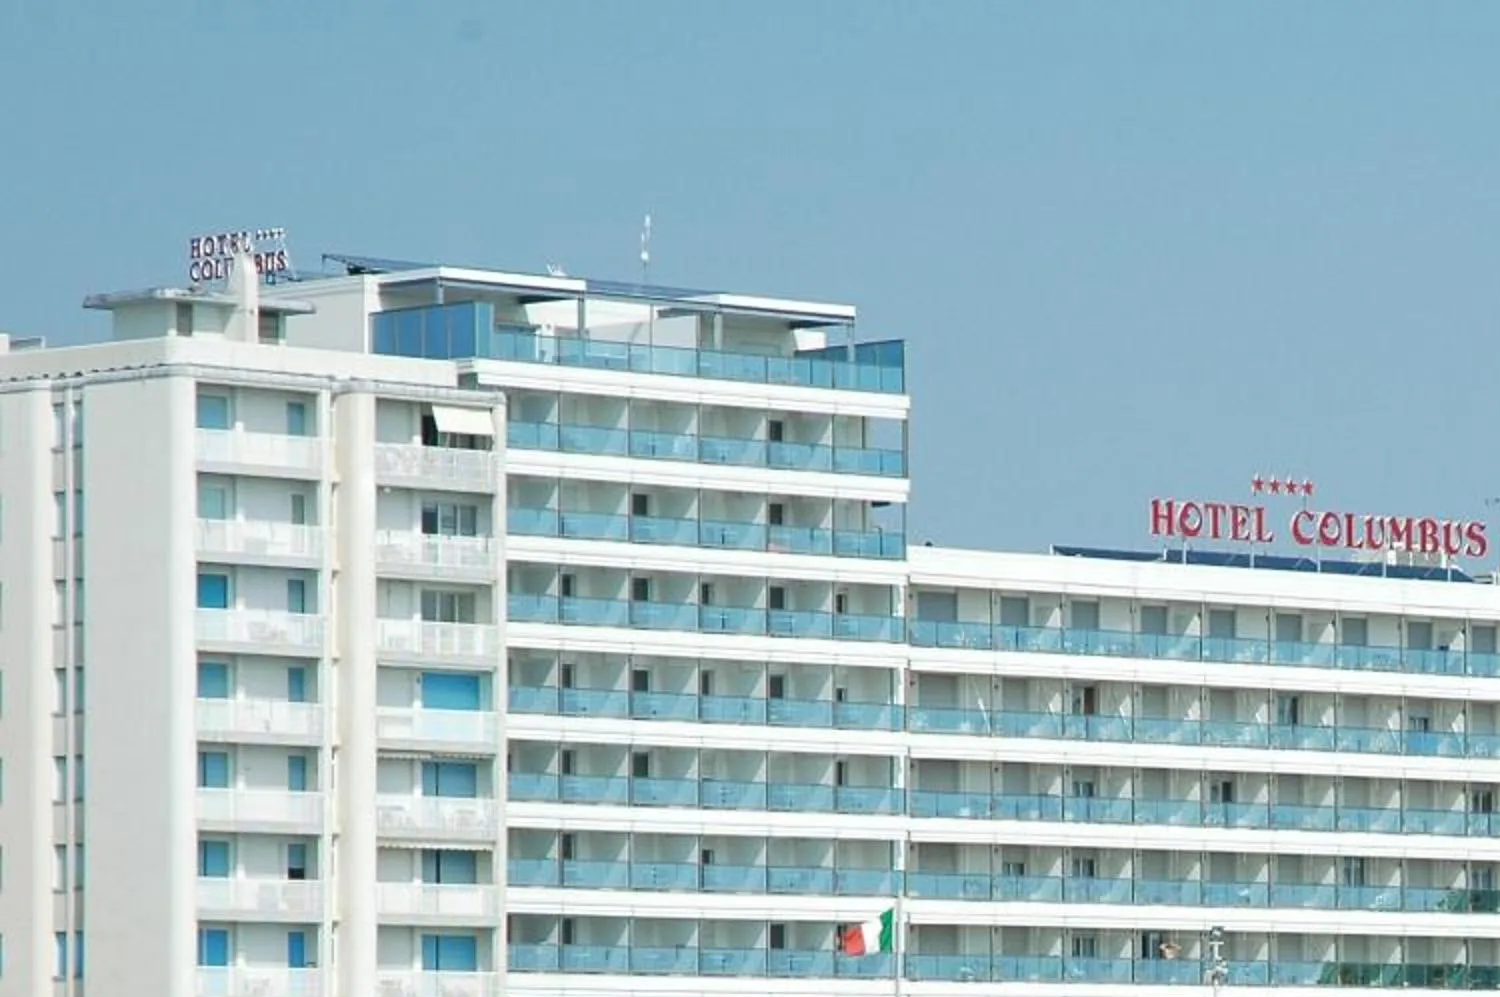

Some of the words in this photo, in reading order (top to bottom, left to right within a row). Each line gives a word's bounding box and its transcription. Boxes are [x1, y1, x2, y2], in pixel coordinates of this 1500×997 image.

[190, 231, 251, 259] HOTEL
[190, 250, 285, 282] COLUBUS
[1151, 498, 1273, 543] HOTEL
[1290, 510, 1487, 557] COLUMBUS
